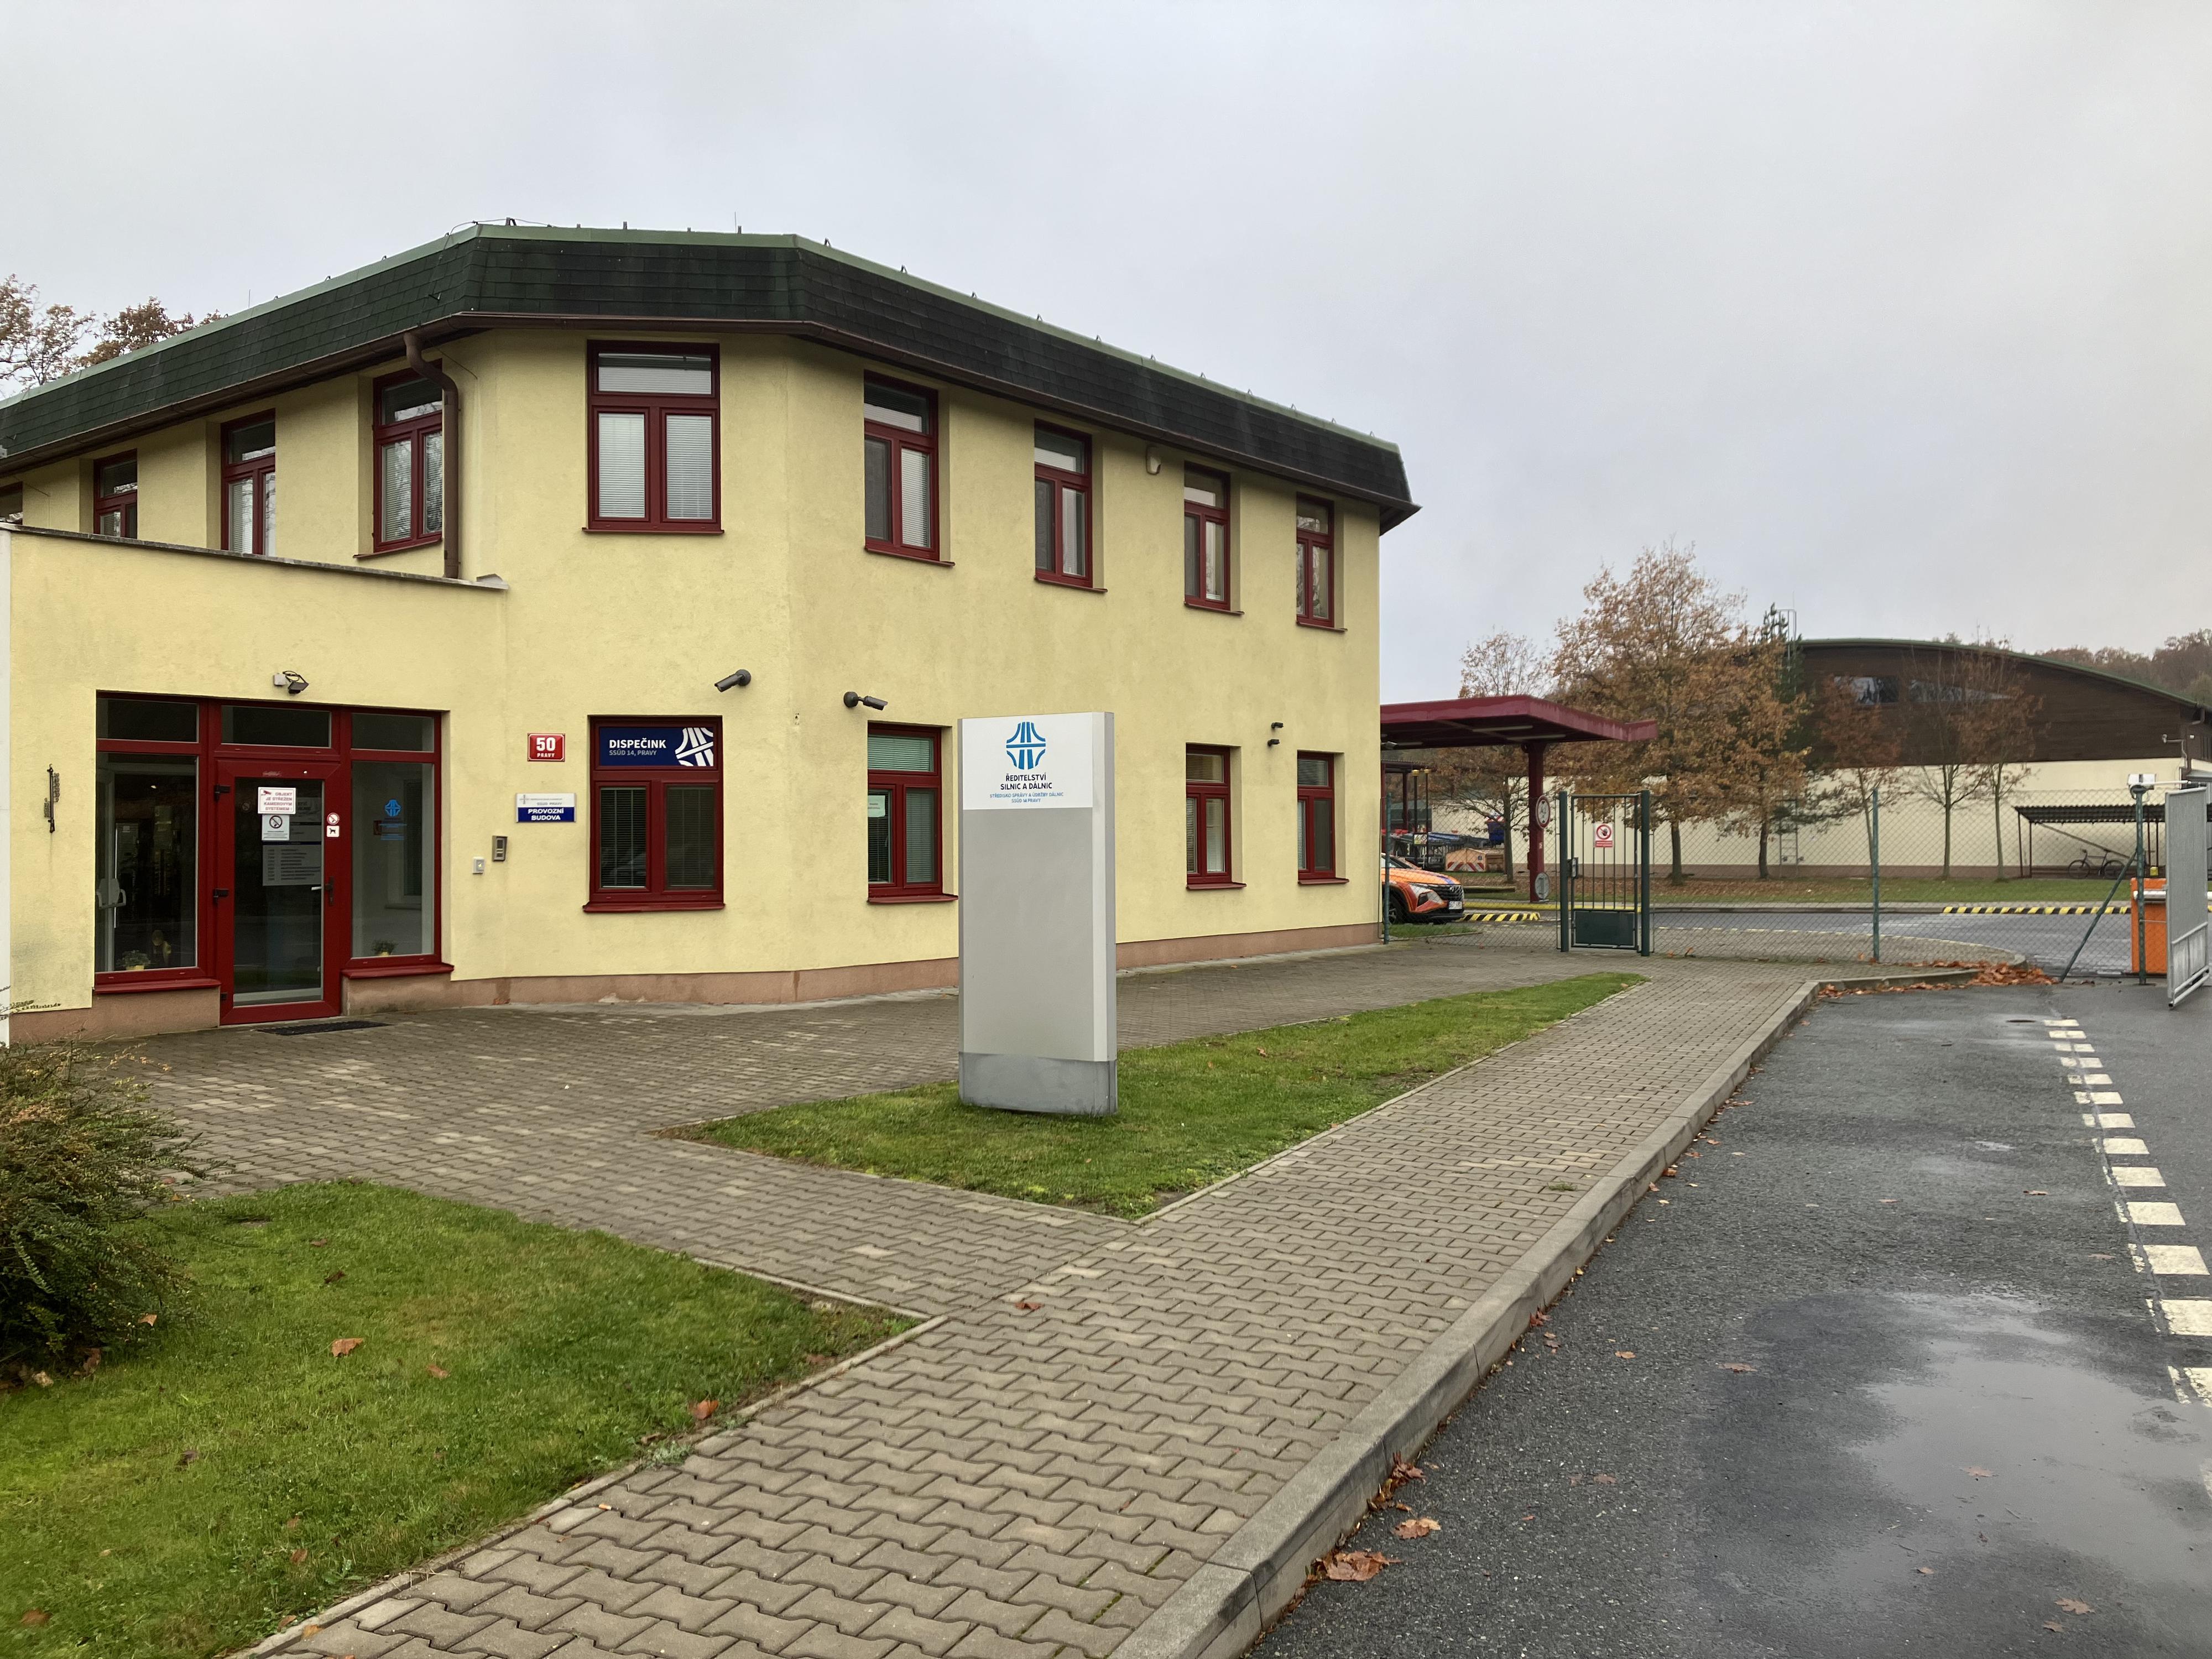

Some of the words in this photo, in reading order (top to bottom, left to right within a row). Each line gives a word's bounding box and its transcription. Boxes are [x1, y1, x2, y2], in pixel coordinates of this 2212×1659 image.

[536, 737, 556, 751] 50
[609, 737, 667, 749] DISPEČINK
[1005, 772, 1046, 781] ŘEDITELSTVÍ
[1029, 781, 1052, 789] DÁLNIC
